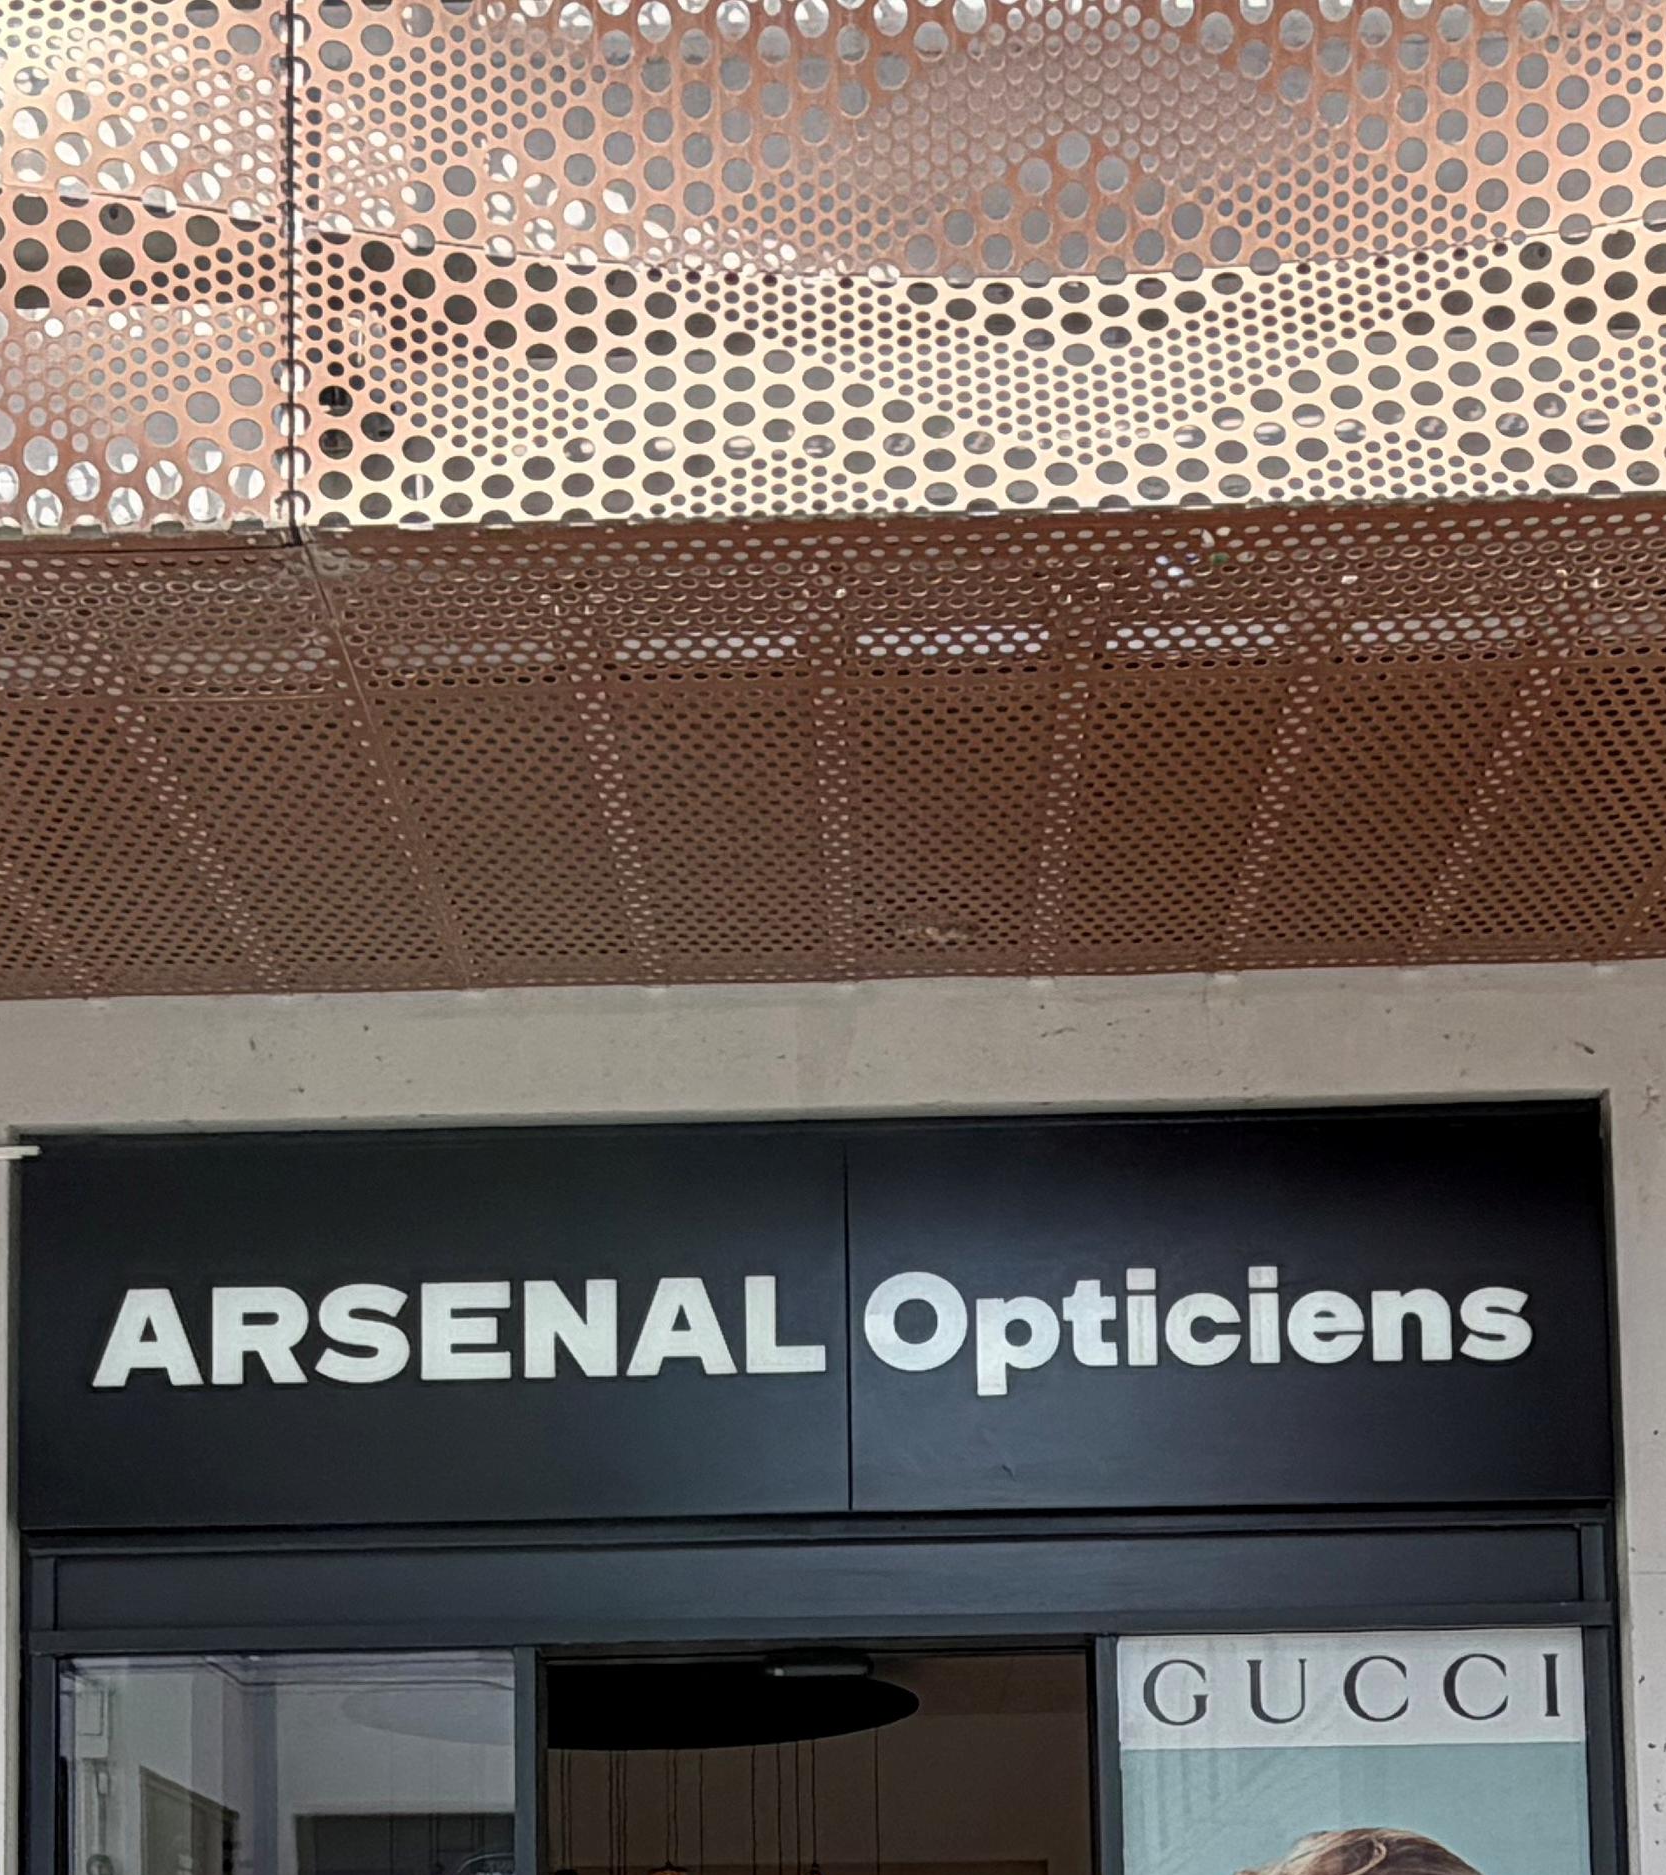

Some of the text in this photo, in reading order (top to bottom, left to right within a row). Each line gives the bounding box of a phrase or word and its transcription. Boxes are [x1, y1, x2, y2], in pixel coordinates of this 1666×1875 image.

[92, 1266, 1534, 1395] ARSENAL Opticiens
[1143, 1652, 1561, 1727] GUCCI
